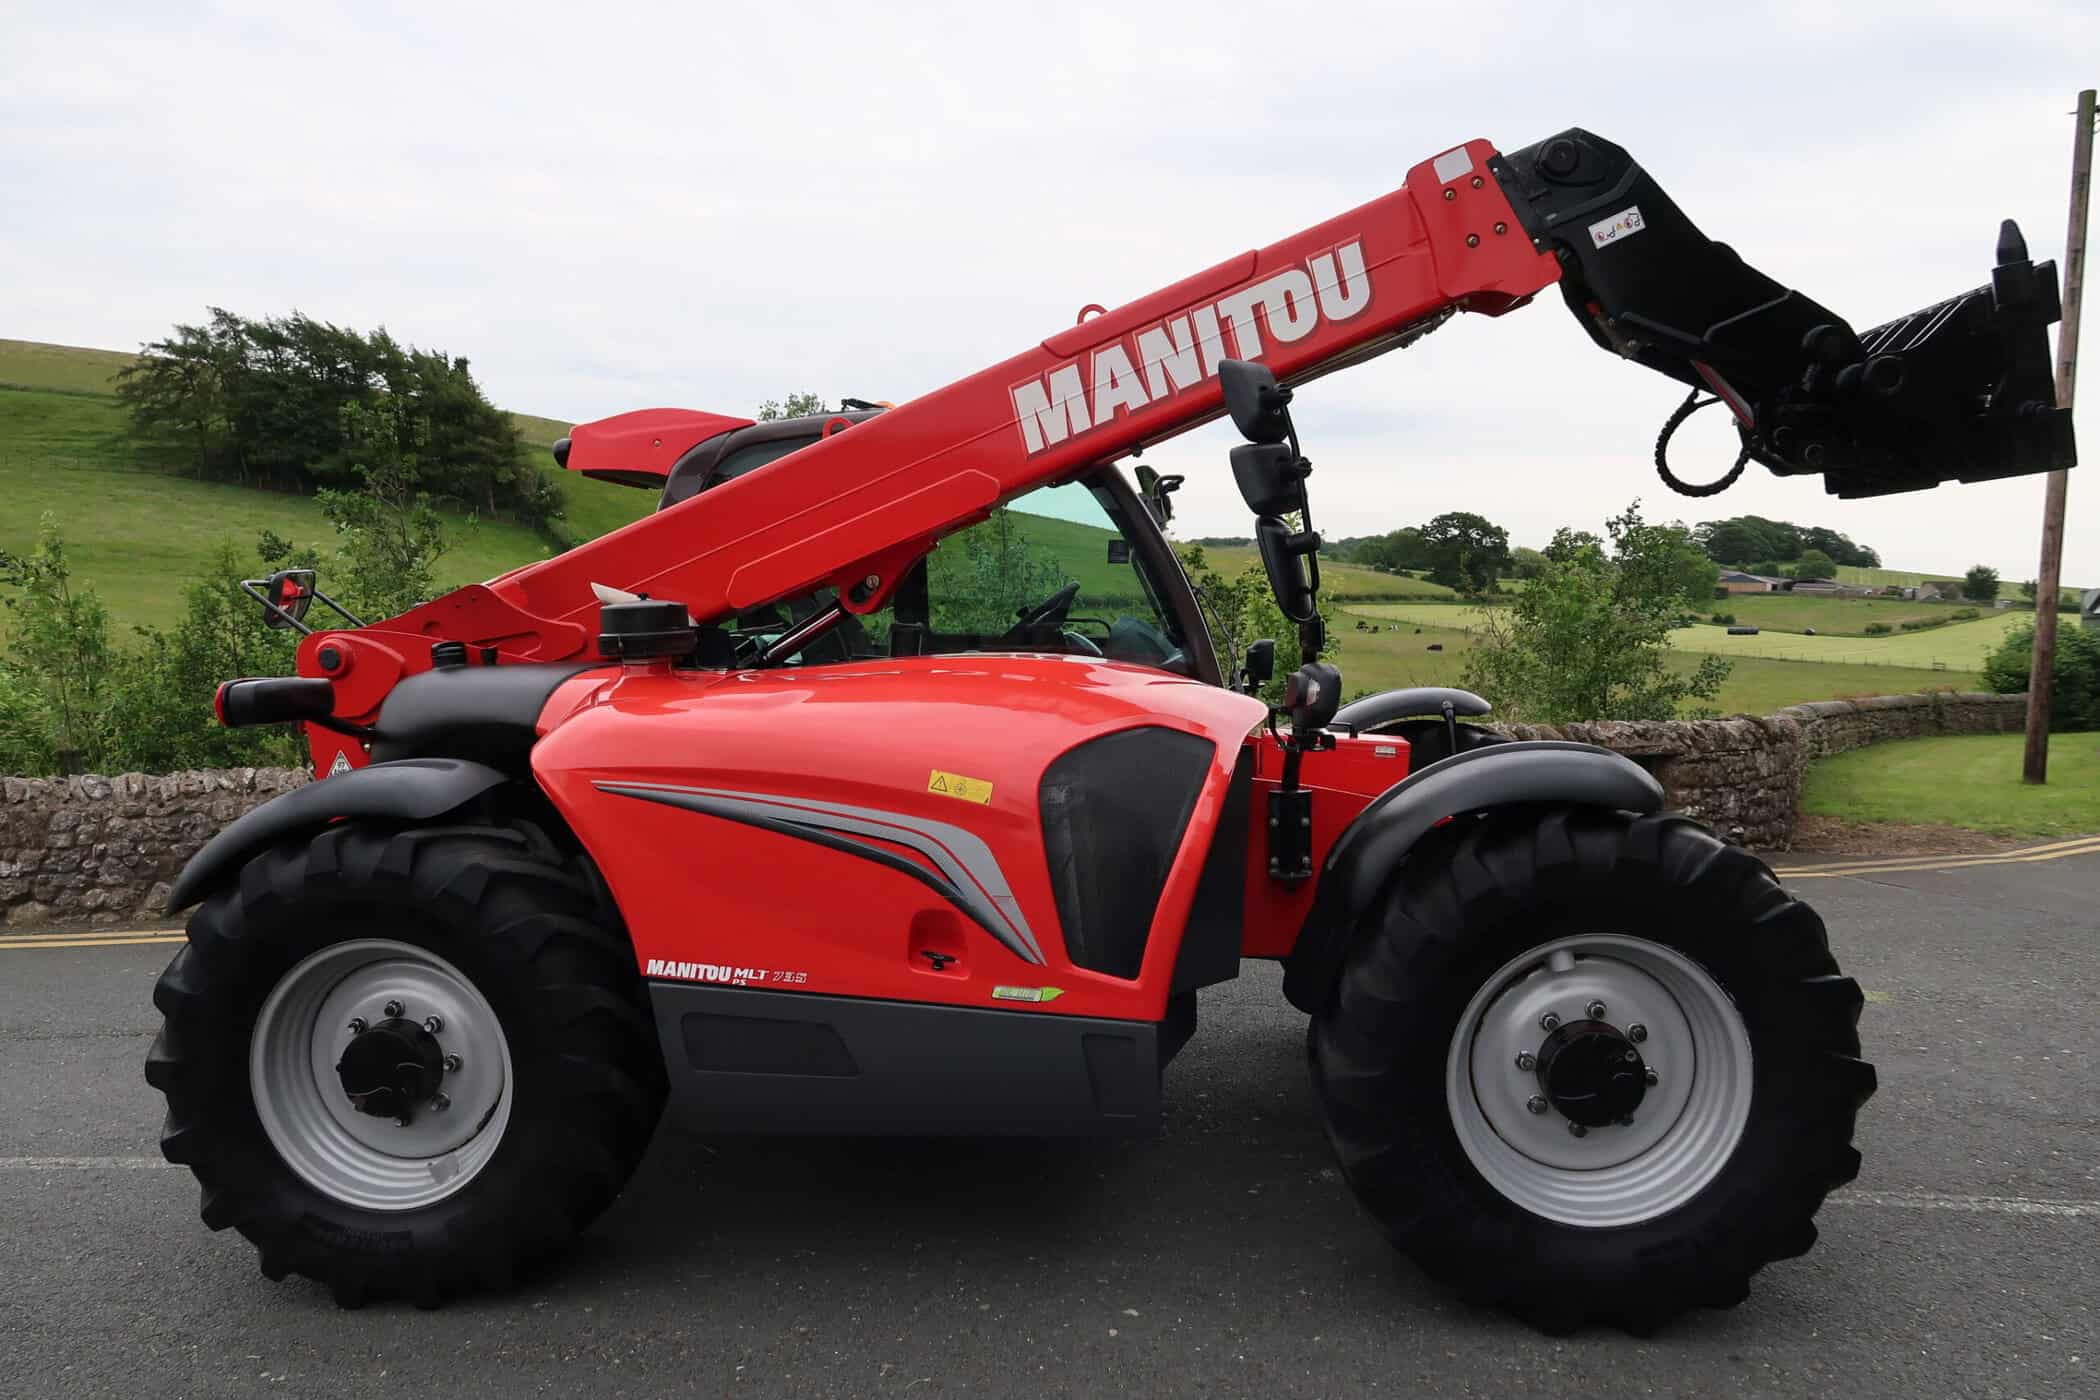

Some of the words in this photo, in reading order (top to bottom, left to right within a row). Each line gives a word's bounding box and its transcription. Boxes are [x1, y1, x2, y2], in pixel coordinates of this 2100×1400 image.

[1012, 241, 1371, 455] MANITOU
[647, 959, 732, 982] MANITOU
[734, 967, 769, 980] MLT
